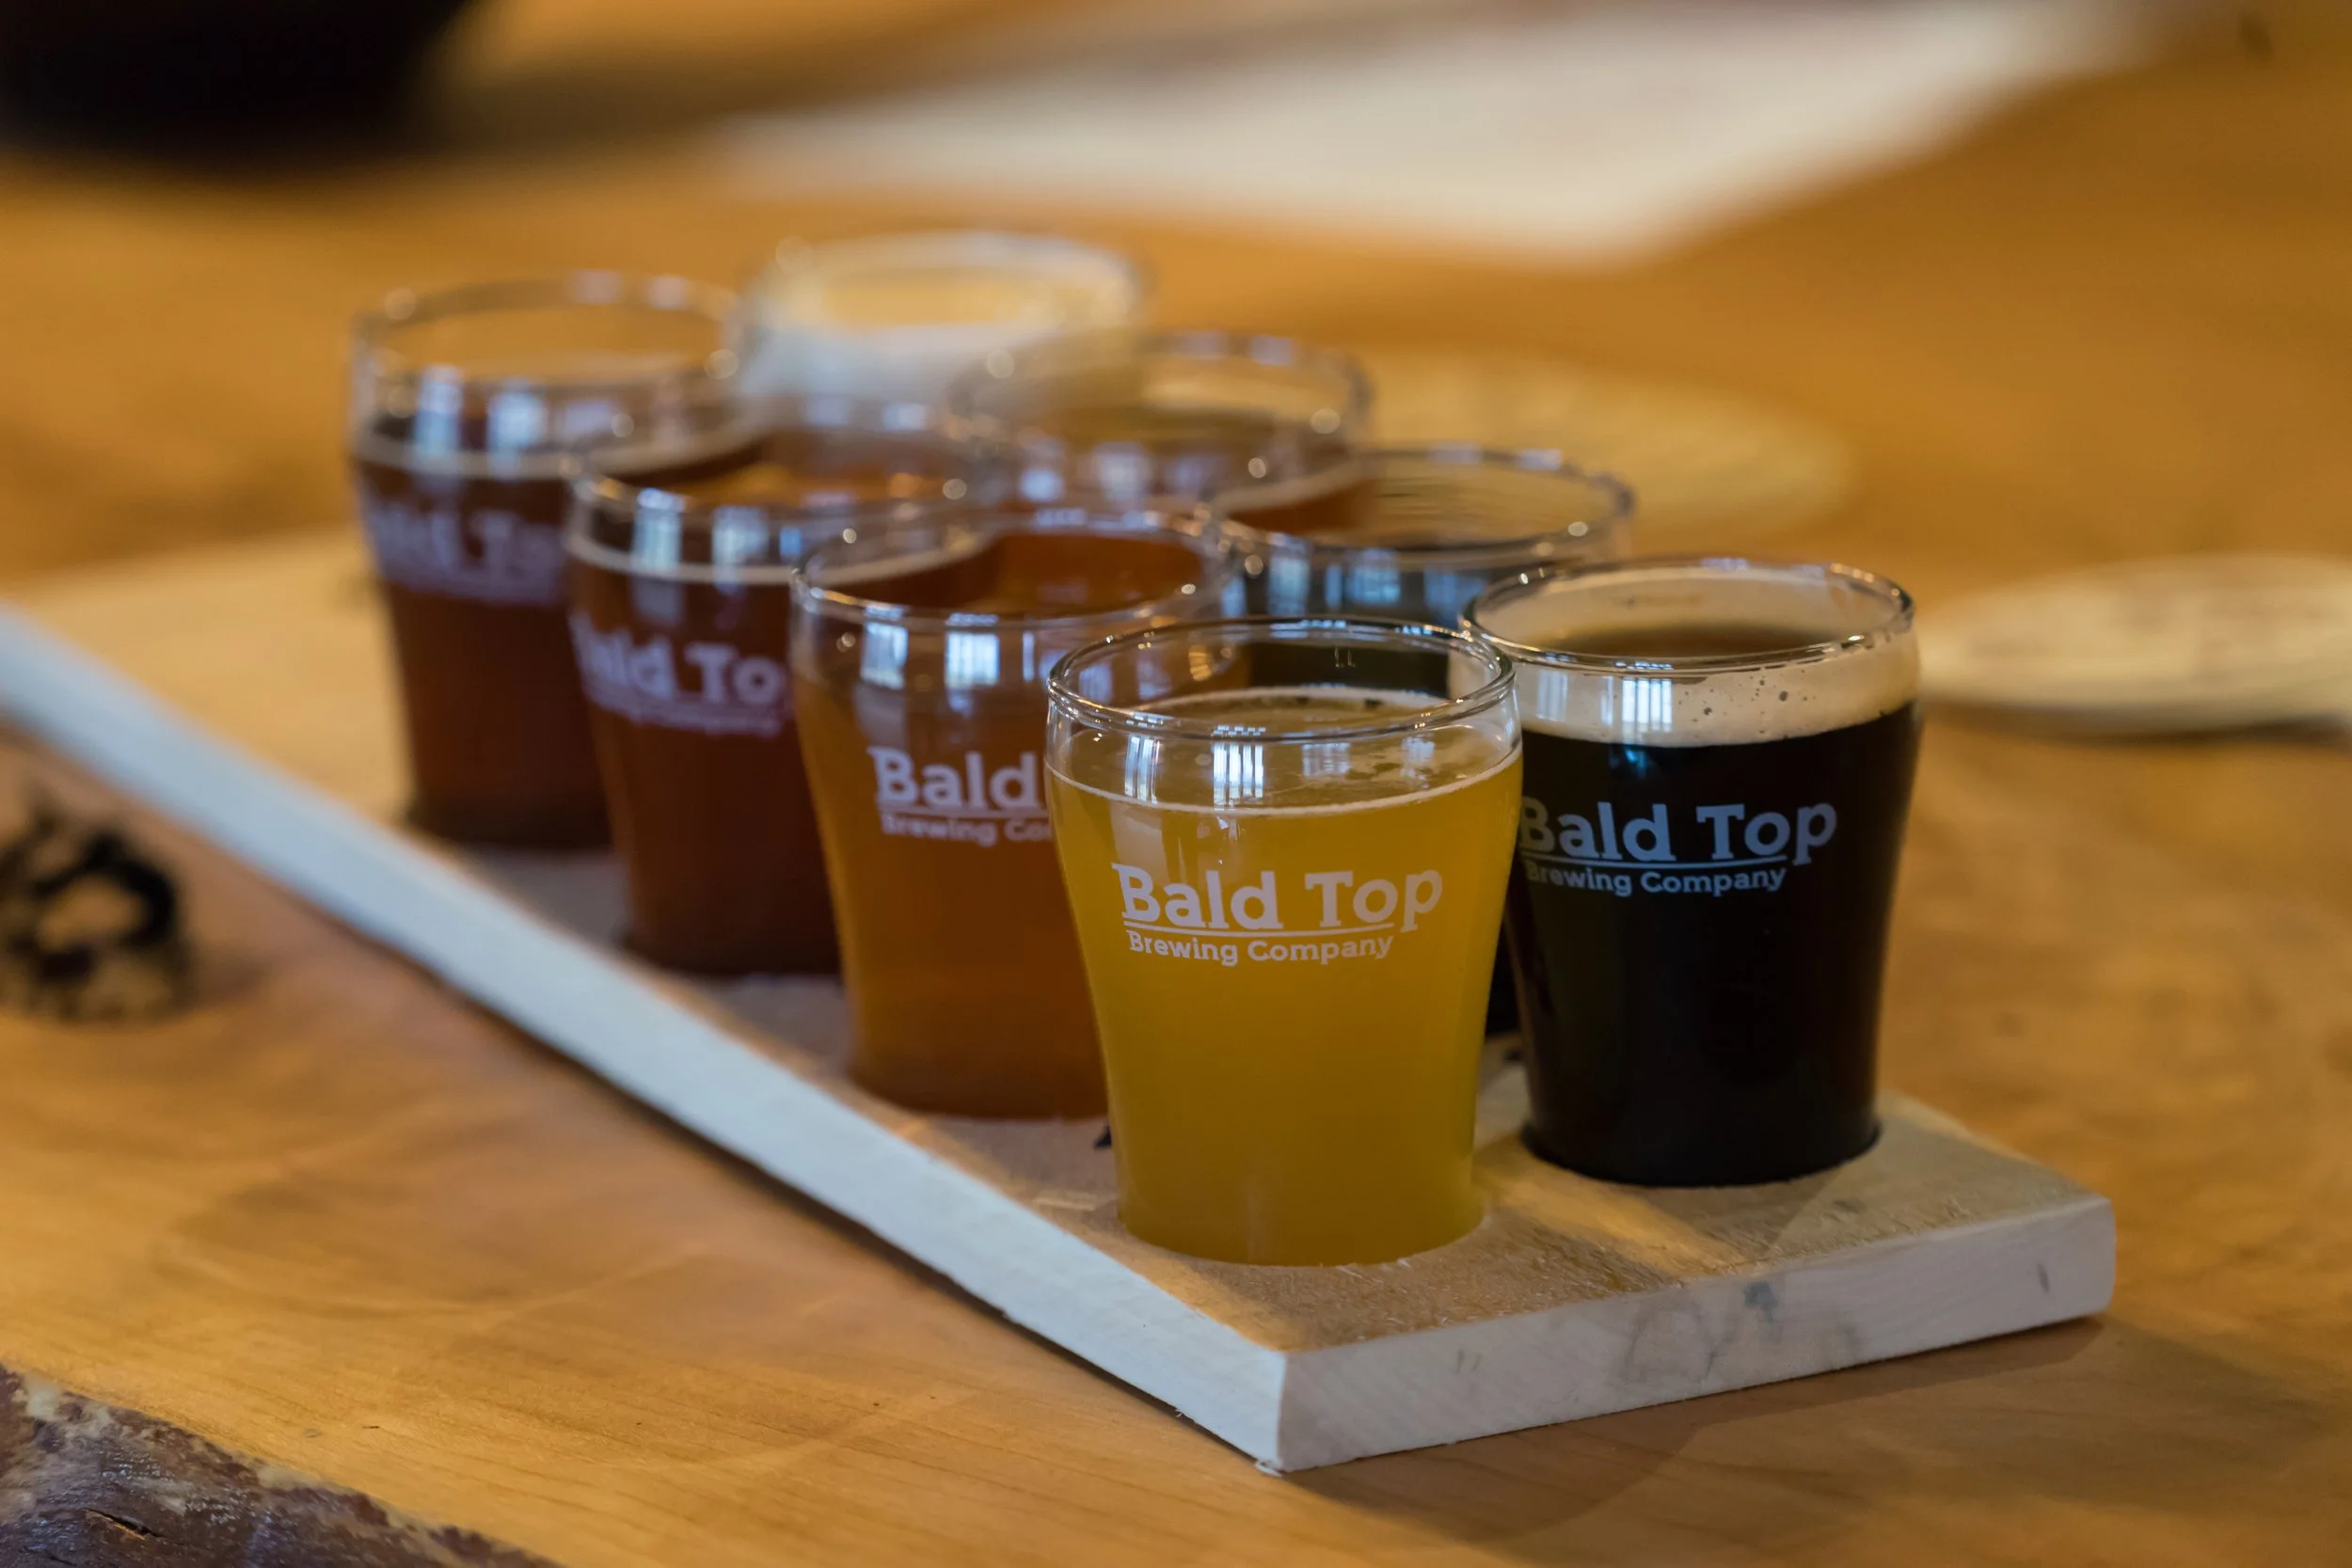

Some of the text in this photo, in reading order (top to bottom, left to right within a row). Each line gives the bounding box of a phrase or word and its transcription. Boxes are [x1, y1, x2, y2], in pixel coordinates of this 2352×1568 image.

[685, 641, 790, 706] To
[868, 746, 1040, 810] Bald
[1519, 797, 1836, 866] Bald Top
[1111, 863, 1442, 933] Bald Top
[1523, 859, 1787, 896] Brewing Company
[1126, 930, 1393, 966] Brewing Company
